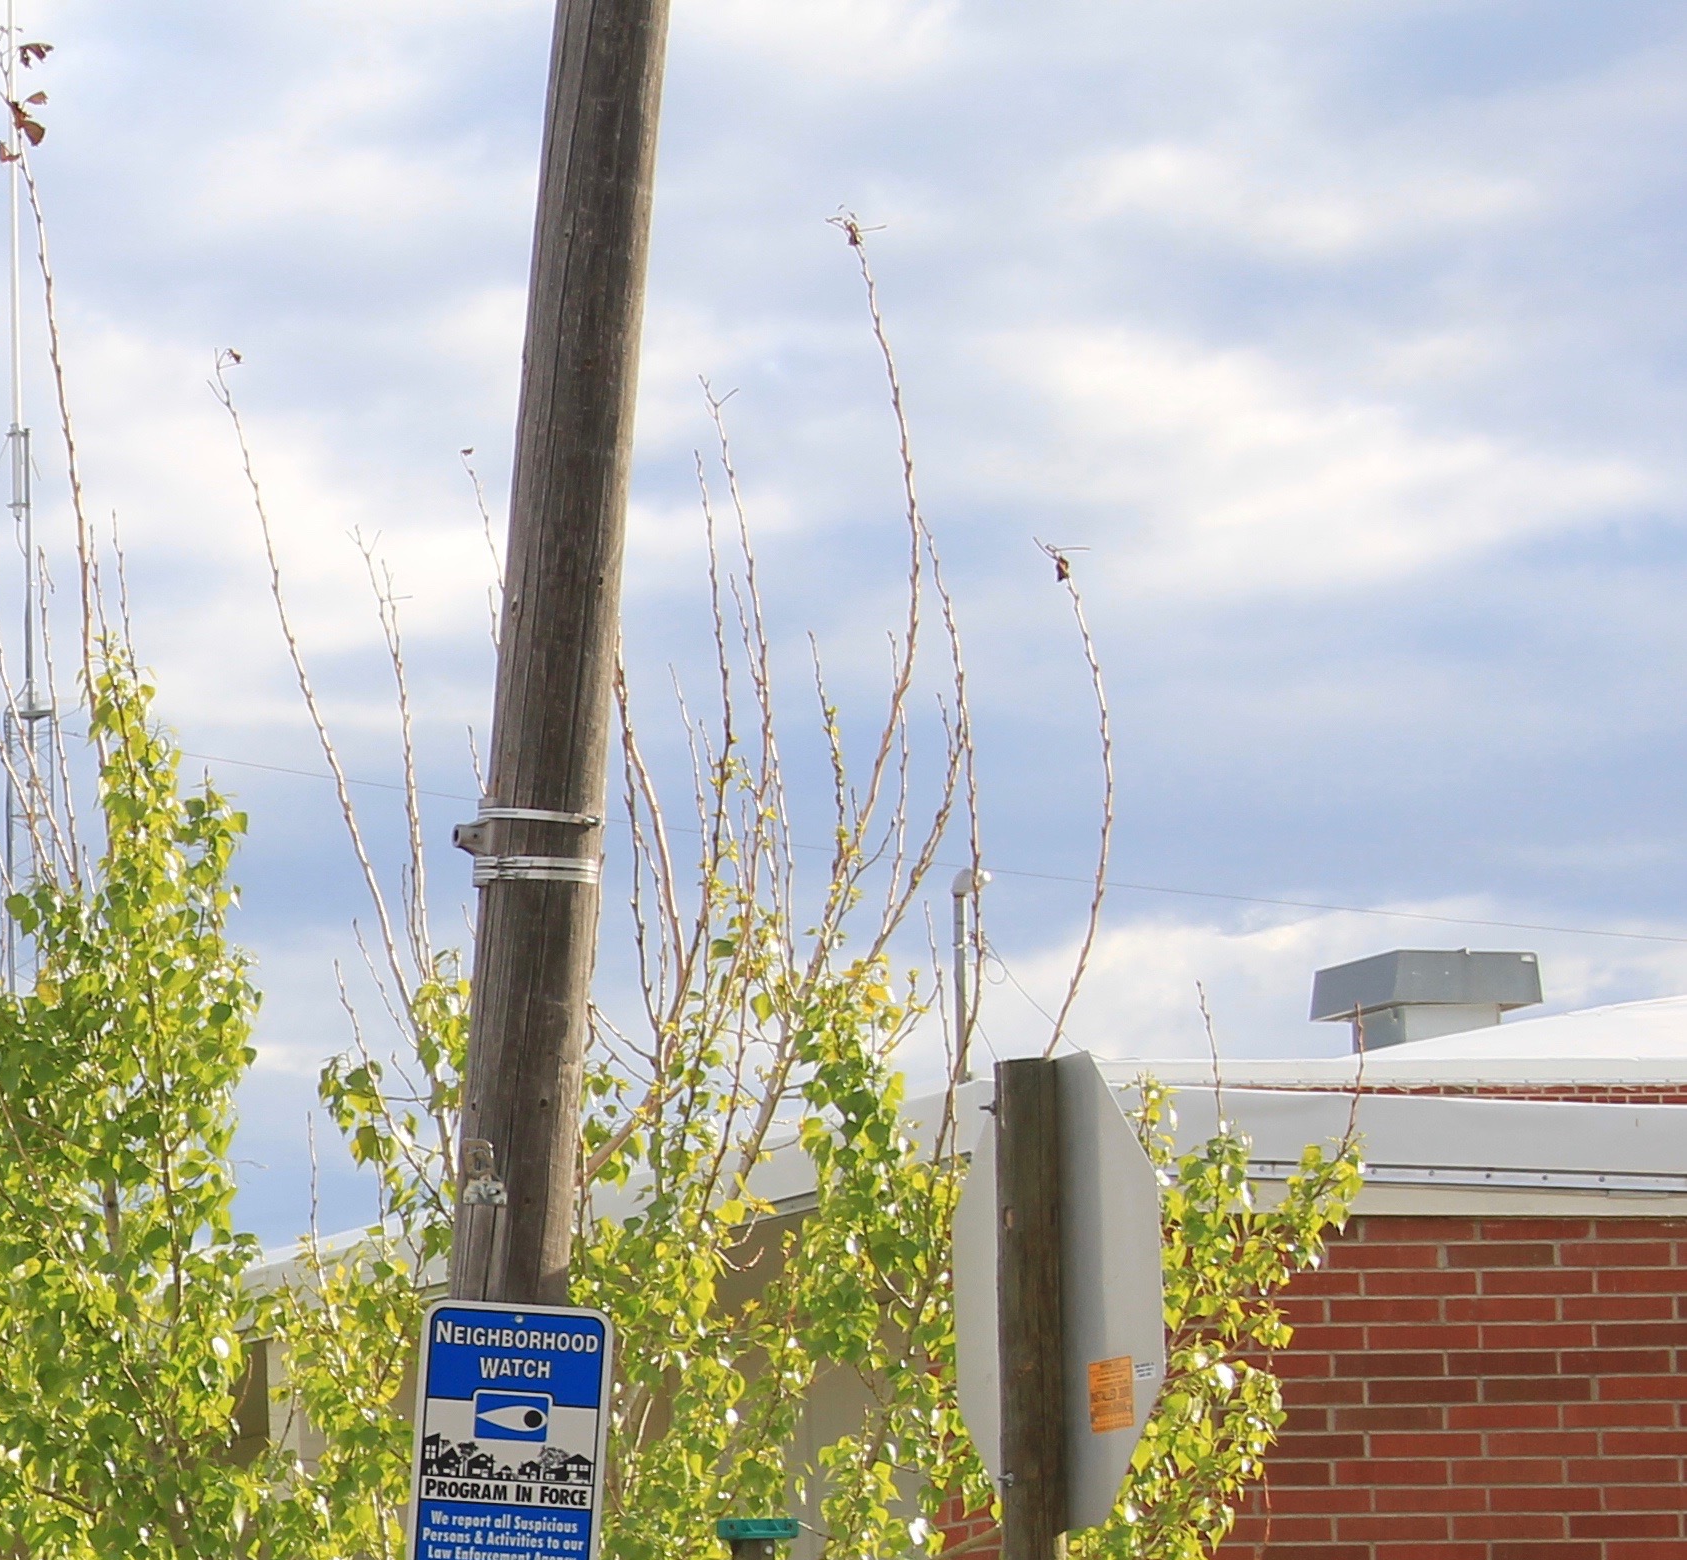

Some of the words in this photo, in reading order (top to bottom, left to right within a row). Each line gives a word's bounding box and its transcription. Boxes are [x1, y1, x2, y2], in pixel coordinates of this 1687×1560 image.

[435, 1320, 599, 1354] NEIGHBORHOOD
[479, 1356, 551, 1380] WATCH
[424, 1478, 508, 1502] PROGRAM
[514, 1484, 532, 1503] IN
[539, 1485, 588, 1507] FORCE
[430, 1509, 450, 1526] We
[451, 1514, 492, 1530] report
[493, 1513, 512, 1530] all
[513, 1515, 579, 1535] Suspicious
[422, 1527, 472, 1545] Persons
[473, 1530, 484, 1546] &
[485, 1531, 544, 1549] Activities
[546, 1537, 561, 1551] to
[562, 1539, 585, 1552] our
